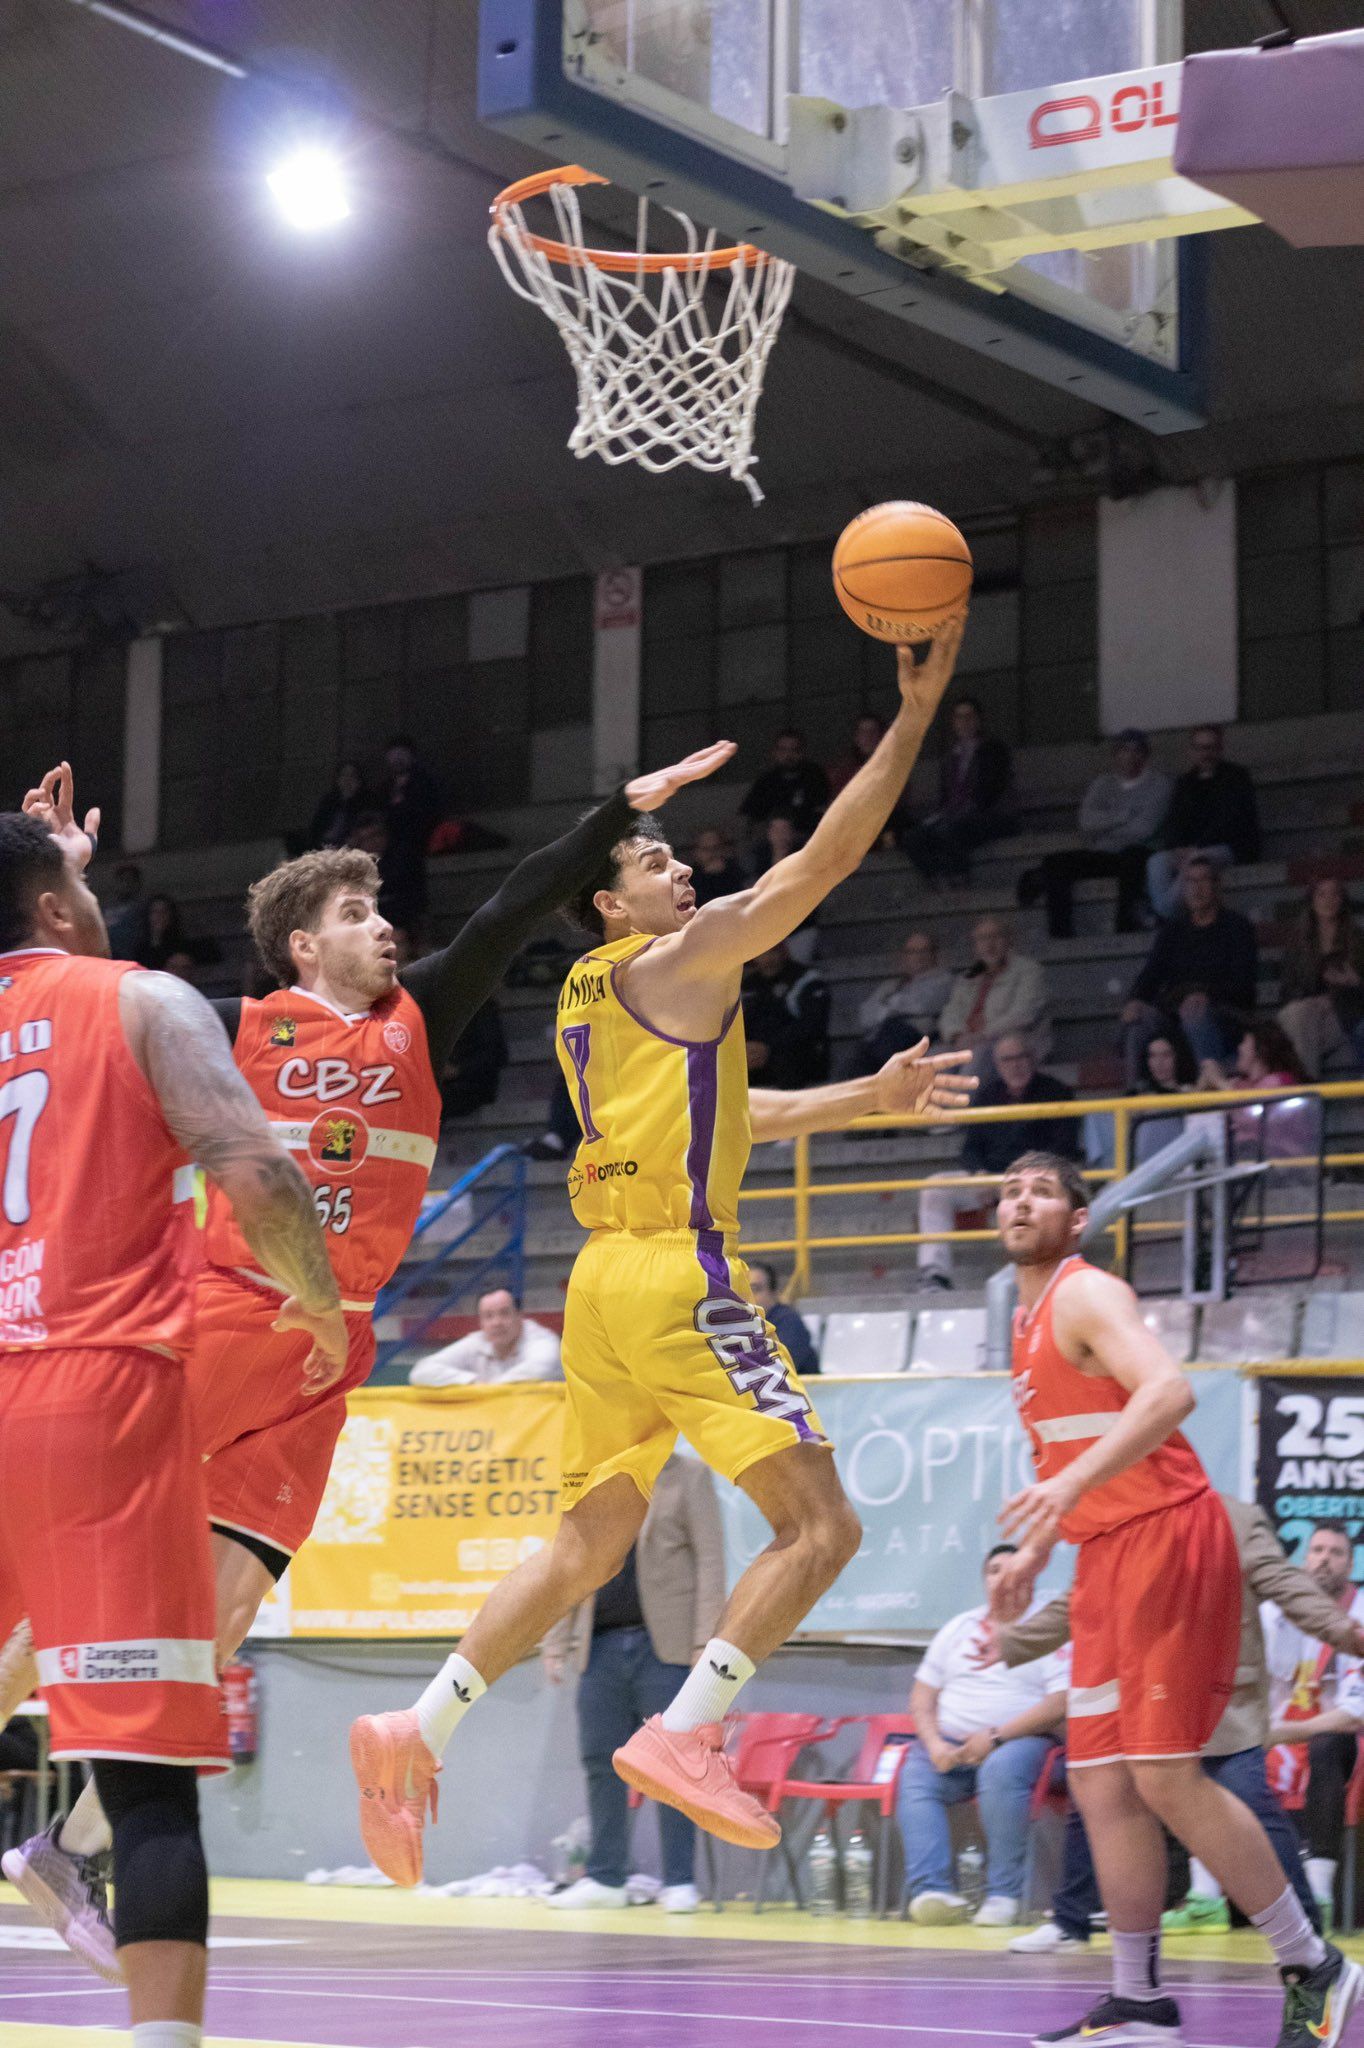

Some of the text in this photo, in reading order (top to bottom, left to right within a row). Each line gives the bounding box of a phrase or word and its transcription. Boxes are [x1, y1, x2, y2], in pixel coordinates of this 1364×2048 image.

[275, 1056, 402, 1107] CBZ
[561, 1022, 605, 1145] 7
[313, 1185, 353, 1236] 55
[0, 1276, 45, 1320] OR
[399, 1430, 495, 1454] ESTUDI
[1275, 1394, 1364, 1459] 25
[398, 1457, 546, 1486] ENERGETIC
[1274, 1459, 1364, 1490] ANYS
[393, 1490, 561, 1519] SENSE COST
